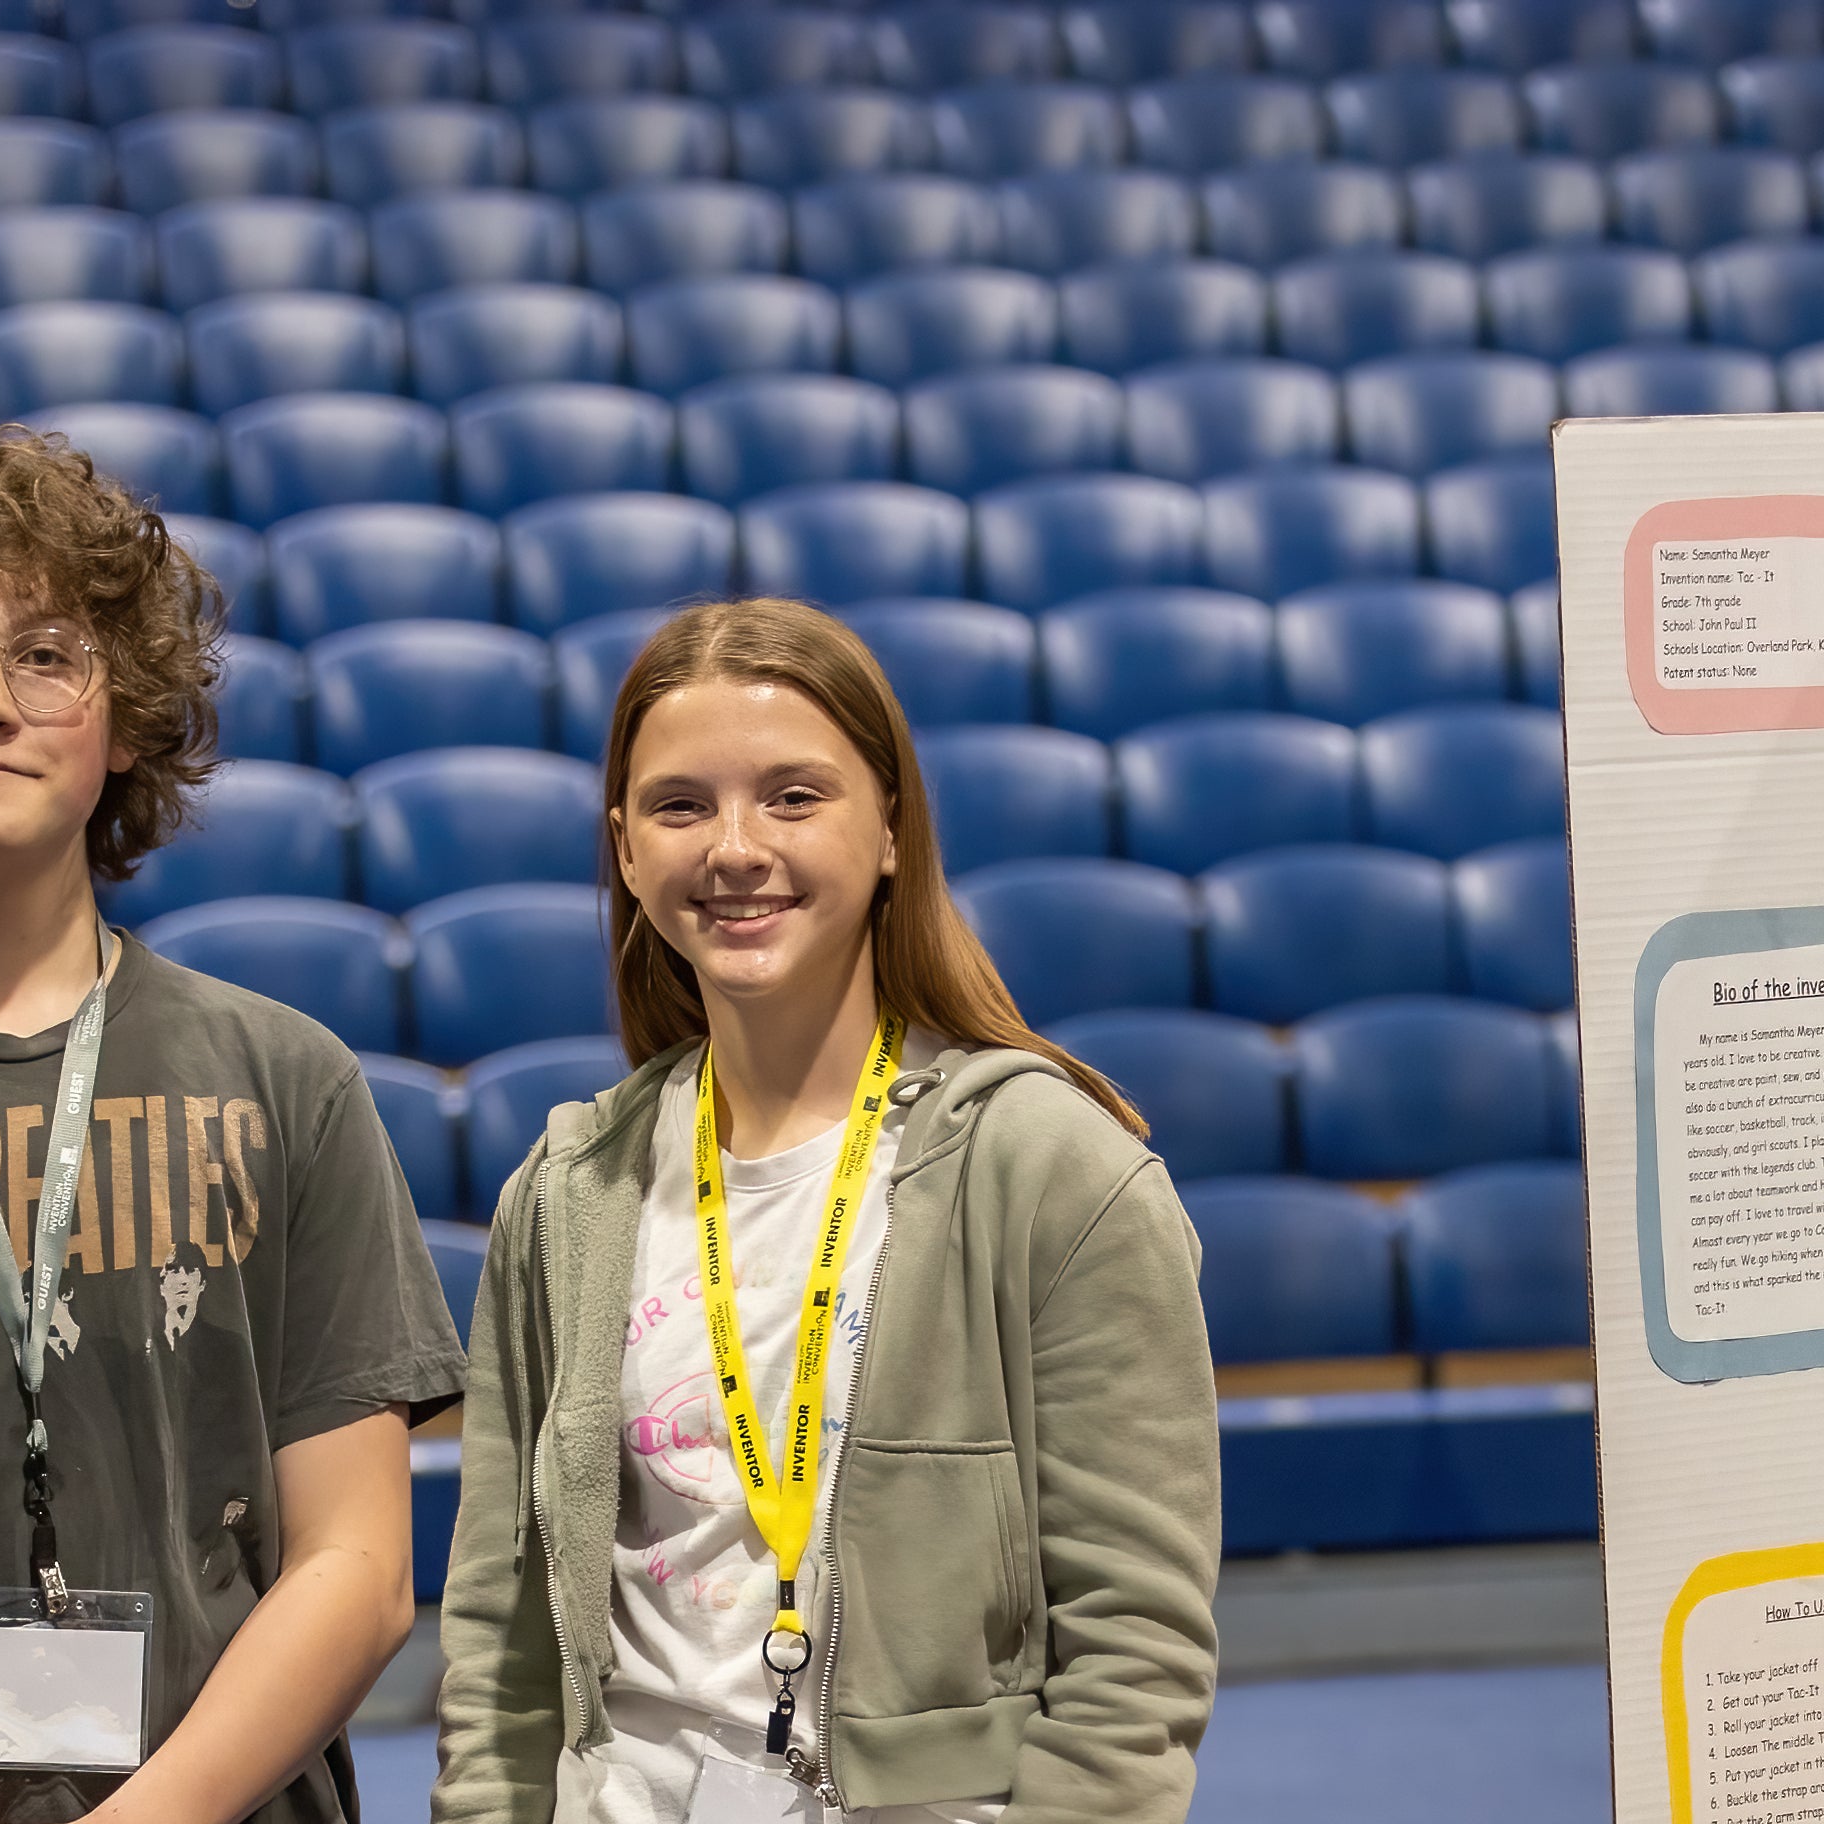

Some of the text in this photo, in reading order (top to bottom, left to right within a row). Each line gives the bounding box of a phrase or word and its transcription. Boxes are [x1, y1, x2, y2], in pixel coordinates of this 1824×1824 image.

[1659, 547, 1770, 562] Name: Samantha Meyer
[1660, 572, 1704, 585] Invention
[1707, 574, 1732, 583] name:
[1736, 570, 1754, 583] Tac
[1763, 570, 1774, 582] It
[1660, 594, 1741, 609] Grade: 7th grade
[1662, 616, 1756, 632] School: John Paul II
[1663, 641, 1699, 655] Schools
[1700, 641, 1743, 654] Location:
[1746, 639, 1789, 652] Overland
[1791, 639, 1815, 651] Park,
[1663, 664, 1757, 679] Patent status: None
[1713, 982, 1736, 1002] Bio
[1741, 980, 1758, 1000] of
[1763, 979, 1794, 999] the
[1699, 1033, 1713, 1047] My
[1715, 1033, 1738, 1043] name
[1750, 1025, 1794, 1040] Samantha
[1796, 1025, 1824, 1038] Meyer
[68, 1072, 85, 1115] GUEST
[844, 1130, 864, 1180] INVENTION
[854, 1114, 876, 1172] CONVENTION
[821, 1197, 848, 1268] INVENTOR
[705, 1216, 721, 1287] INVENTOR
[37, 1264, 53, 1310] GUEST
[811, 1310, 828, 1375] CONVENTION
[803, 1329, 816, 1384] INVENTION
[734, 1413, 764, 1489] INVENTOR
[791, 1404, 810, 1482] INVENTOR
[1765, 1604, 1790, 1620] How
[1794, 1601, 1813, 1616] To
[1716, 1670, 1742, 1684] Take
[1742, 1669, 1765, 1684] your
[1767, 1662, 1799, 1681] jacket
[1801, 1657, 1818, 1672] off
[1722, 1695, 1740, 1709] Get
[1743, 1694, 1759, 1706] out
[1761, 1691, 1784, 1706] your
[1786, 1684, 1819, 1699] Tac-It
[1723, 1718, 1741, 1733] Roll
[1743, 1718, 1766, 1734] your
[1768, 1711, 1799, 1731] jacket
[1803, 1709, 1822, 1721] into
[1724, 1744, 1758, 1758] Loosen
[1760, 1738, 1780, 1751] The
[1782, 1733, 1815, 1749] middle
[1725, 1769, 1741, 1782] Put
[1742, 1767, 1766, 1783] your
[1768, 1760, 1799, 1780] jacket
[1803, 1760, 1812, 1769] in
[1726, 1790, 1758, 1807] Buckle
[1760, 1788, 1778, 1801] the
[1780, 1786, 1807, 1799] strap
